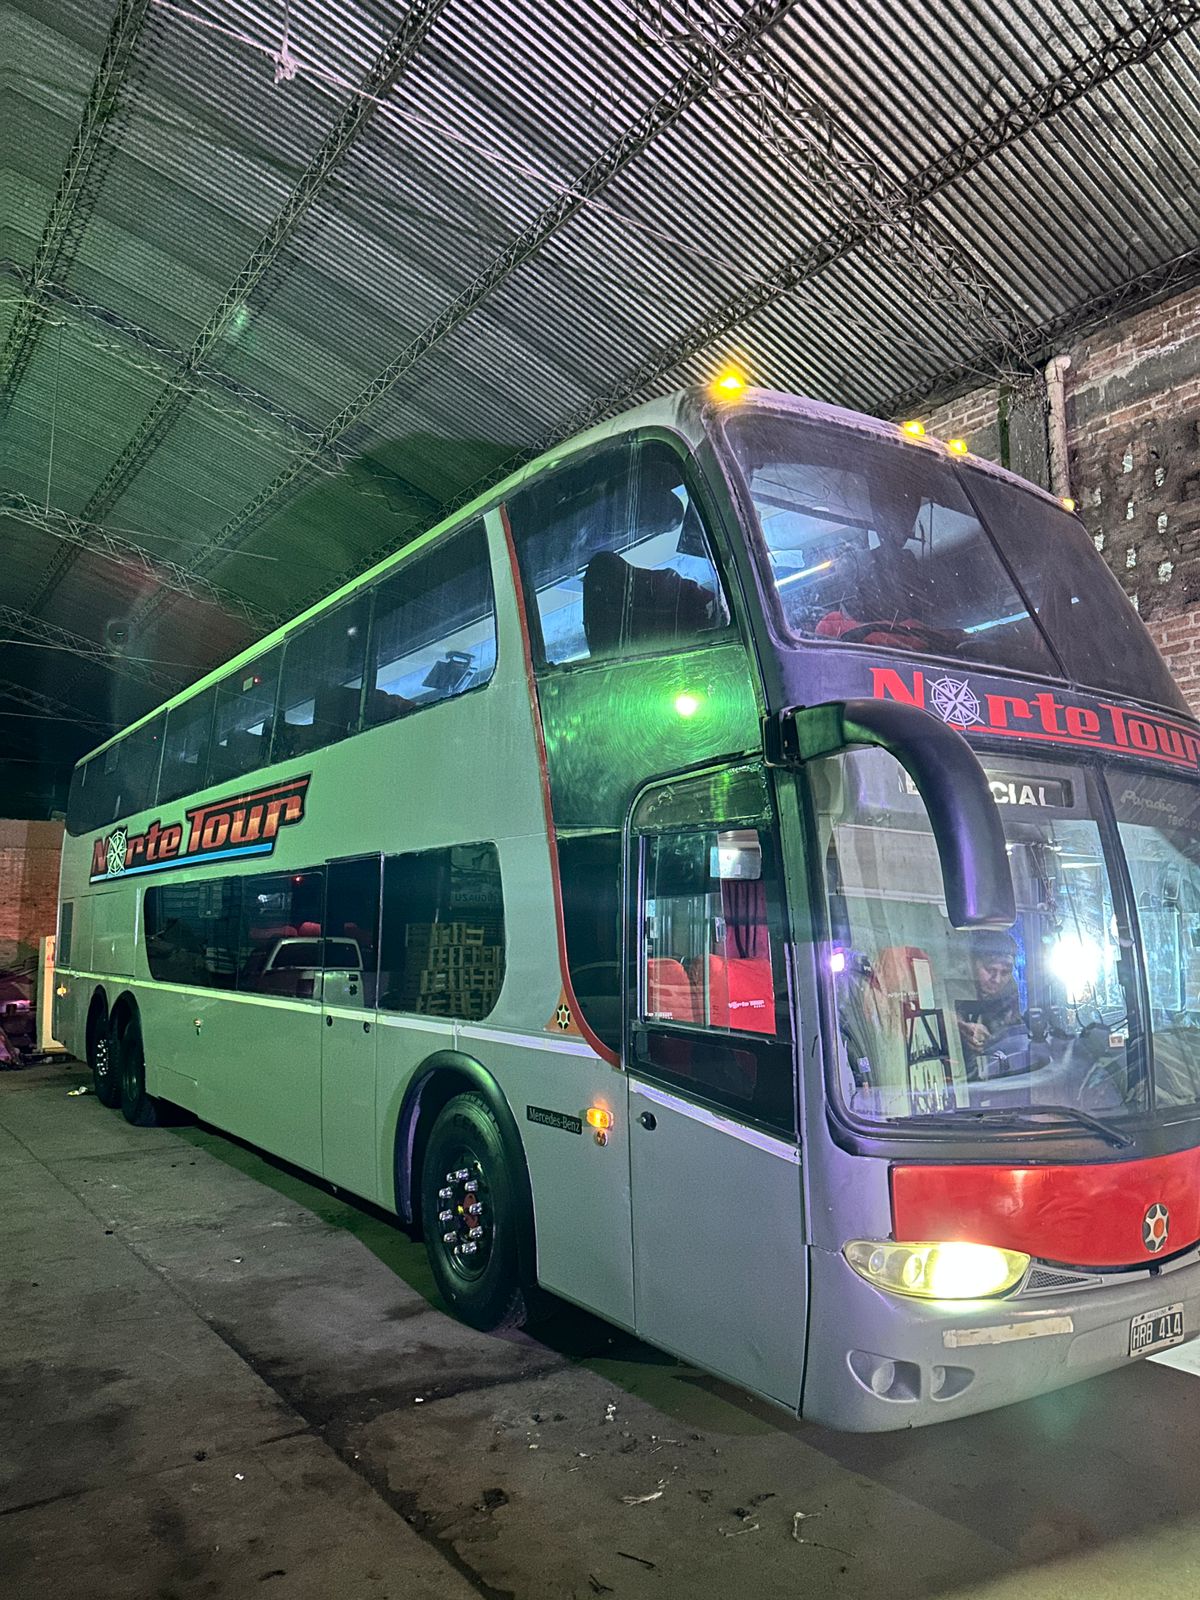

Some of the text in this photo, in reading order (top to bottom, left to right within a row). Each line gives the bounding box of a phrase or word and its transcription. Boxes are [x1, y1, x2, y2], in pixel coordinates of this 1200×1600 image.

[188, 780, 308, 853] Tour
[529, 1107, 580, 1132] Mercedes-Benz
[1133, 1321, 1153, 1349] HRB
[1159, 1313, 1181, 1338] 414
